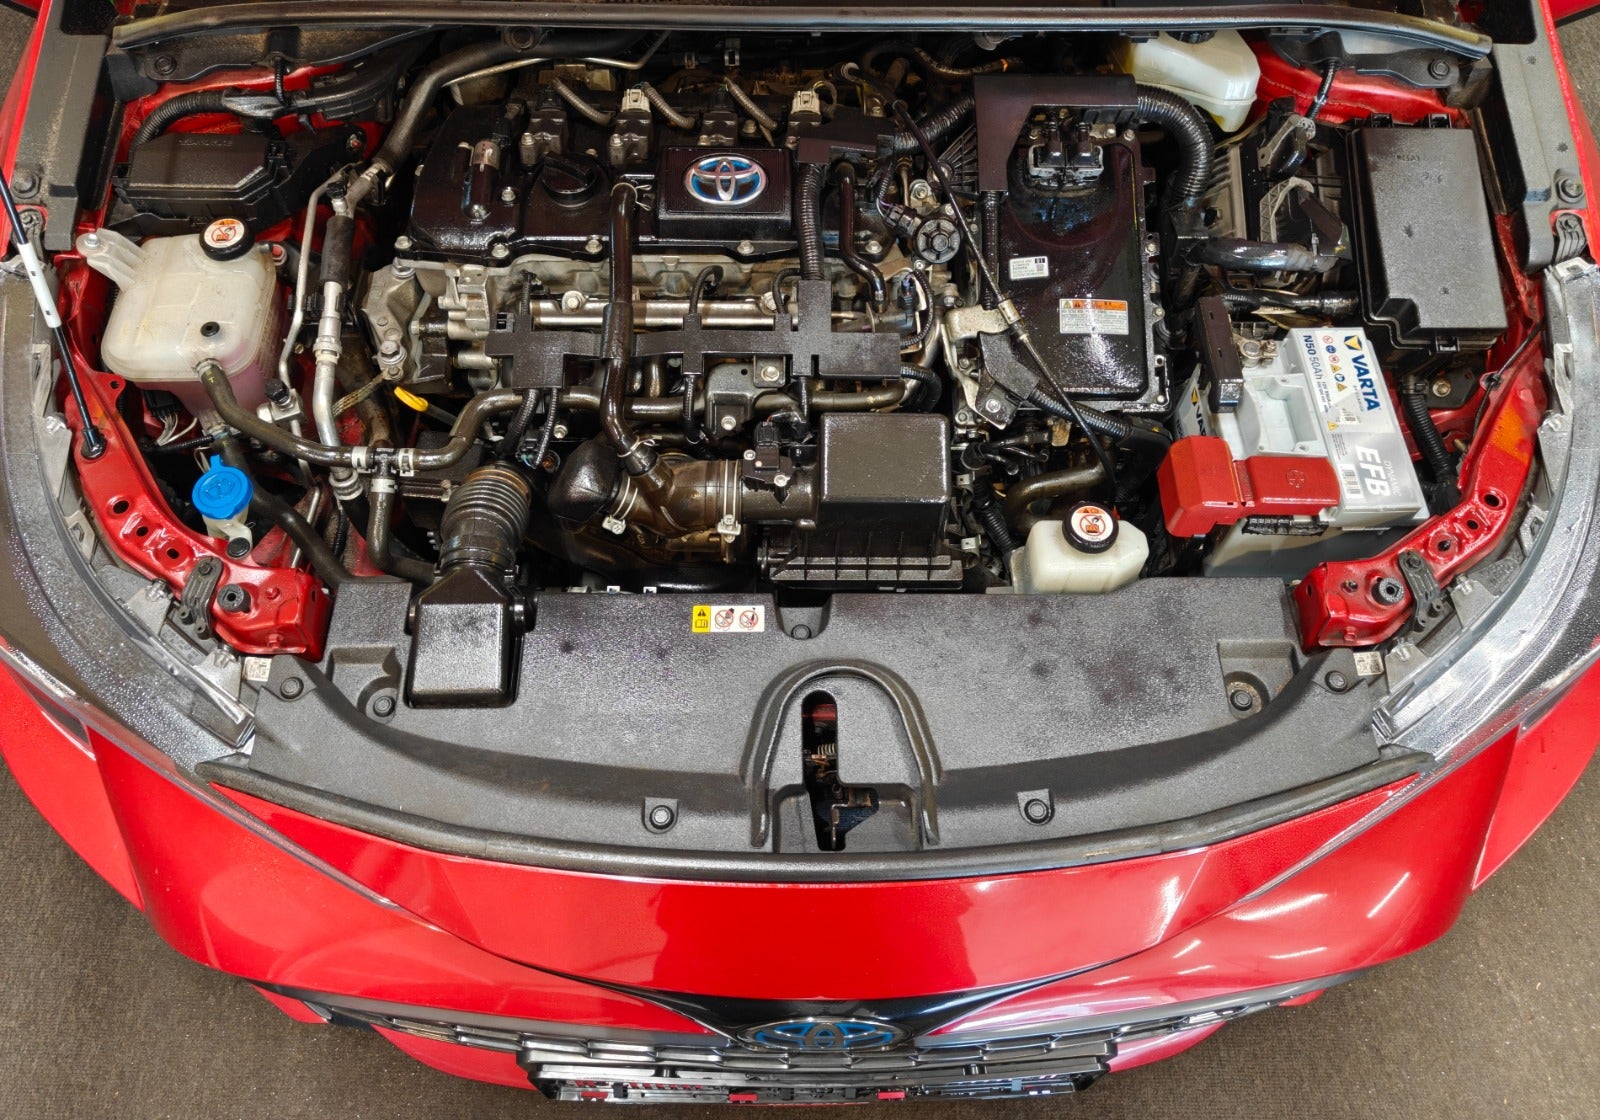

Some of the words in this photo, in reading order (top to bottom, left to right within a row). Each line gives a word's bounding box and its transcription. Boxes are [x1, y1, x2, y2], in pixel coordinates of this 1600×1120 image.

[1303, 335, 1317, 355] N50
[1309, 356, 1324, 380] 50Ah
[1351, 354, 1381, 411] VARTA
[1355, 446, 1391, 496] EFB
[1383, 460, 1402, 497] DYNAMIC
